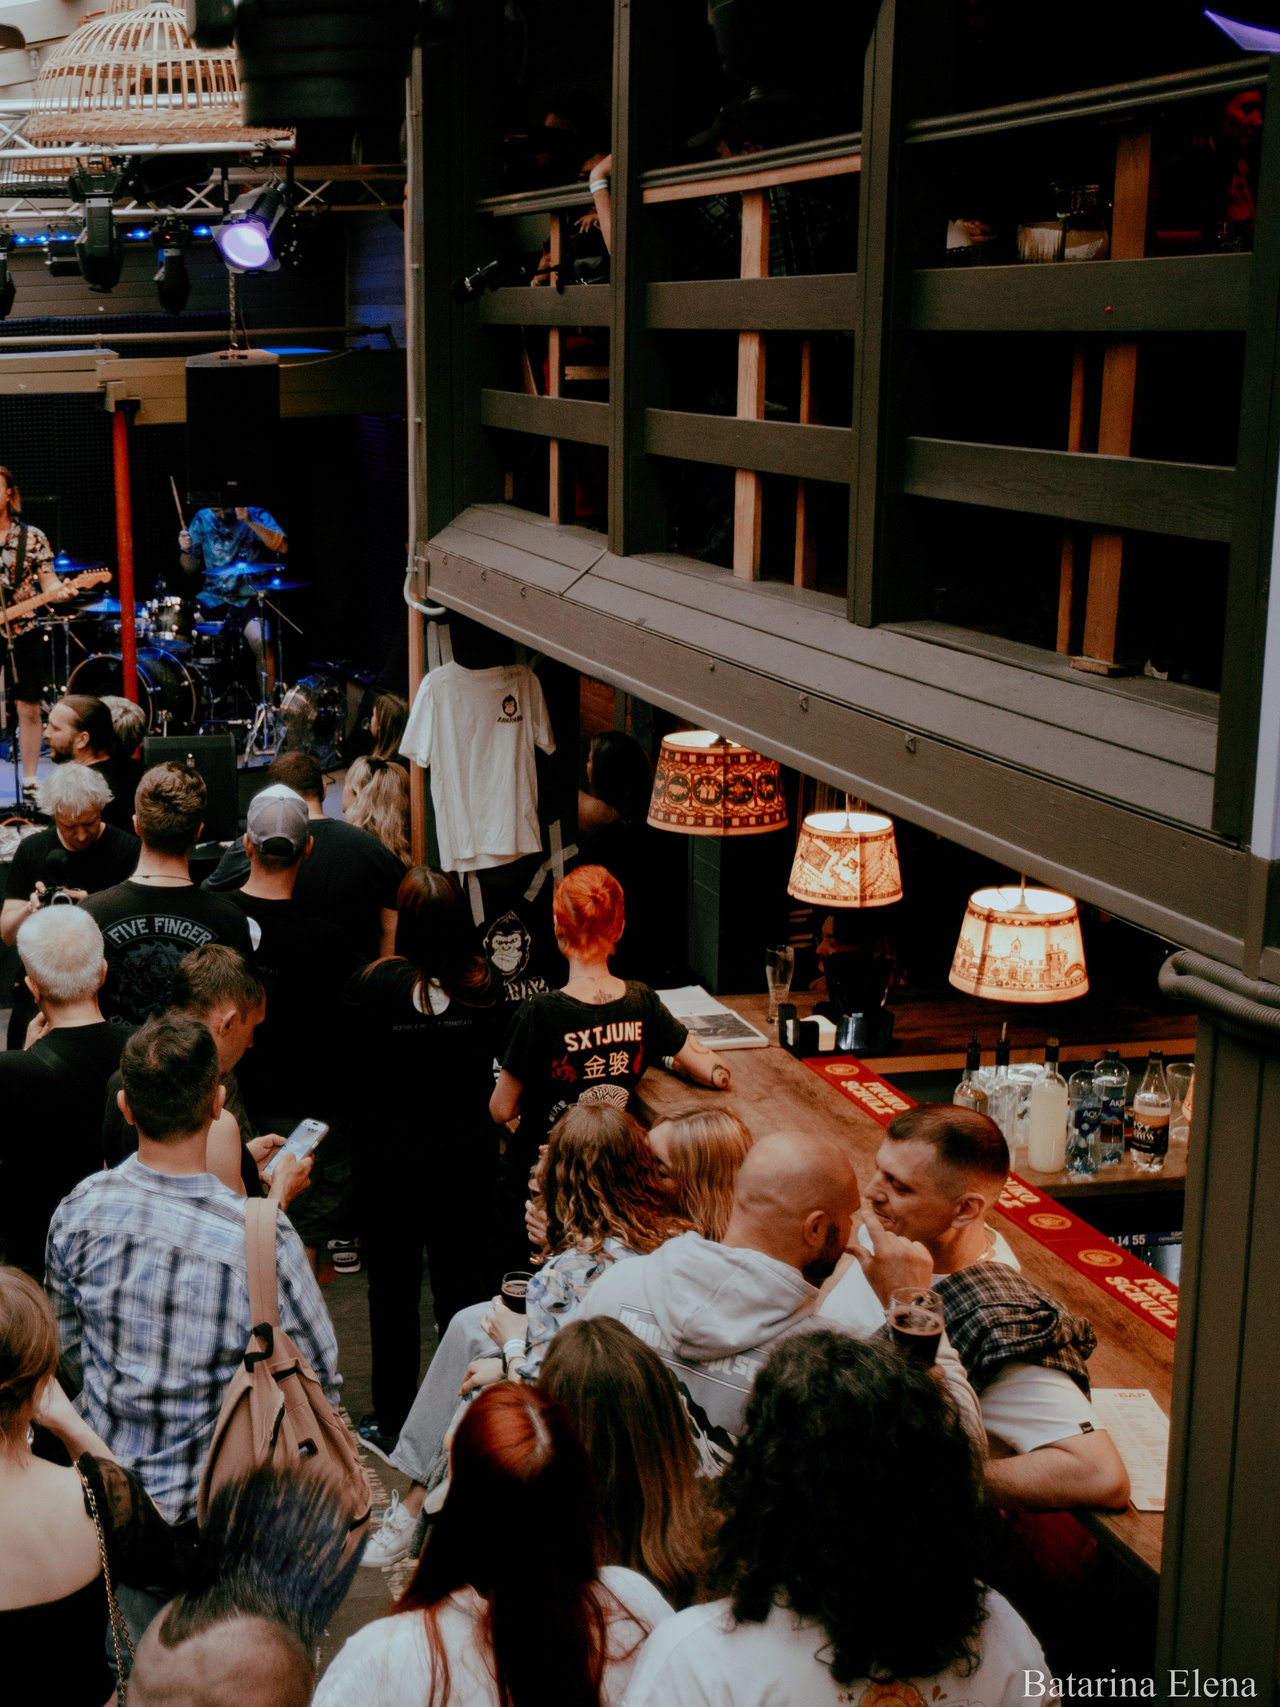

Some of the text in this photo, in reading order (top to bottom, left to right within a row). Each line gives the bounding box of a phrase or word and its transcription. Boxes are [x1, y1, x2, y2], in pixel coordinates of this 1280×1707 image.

[107, 917, 212, 947] FIVE FINGER
[564, 1021, 642, 1052] SXTJUNE
[862, 1081, 911, 1111] FRUKO
[1003, 1177, 1041, 1203] UKO
[1132, 1234, 1146, 1246] 55
[1105, 1276, 1177, 1329] SCHUL
[1133, 1278, 1178, 1312] FRU
